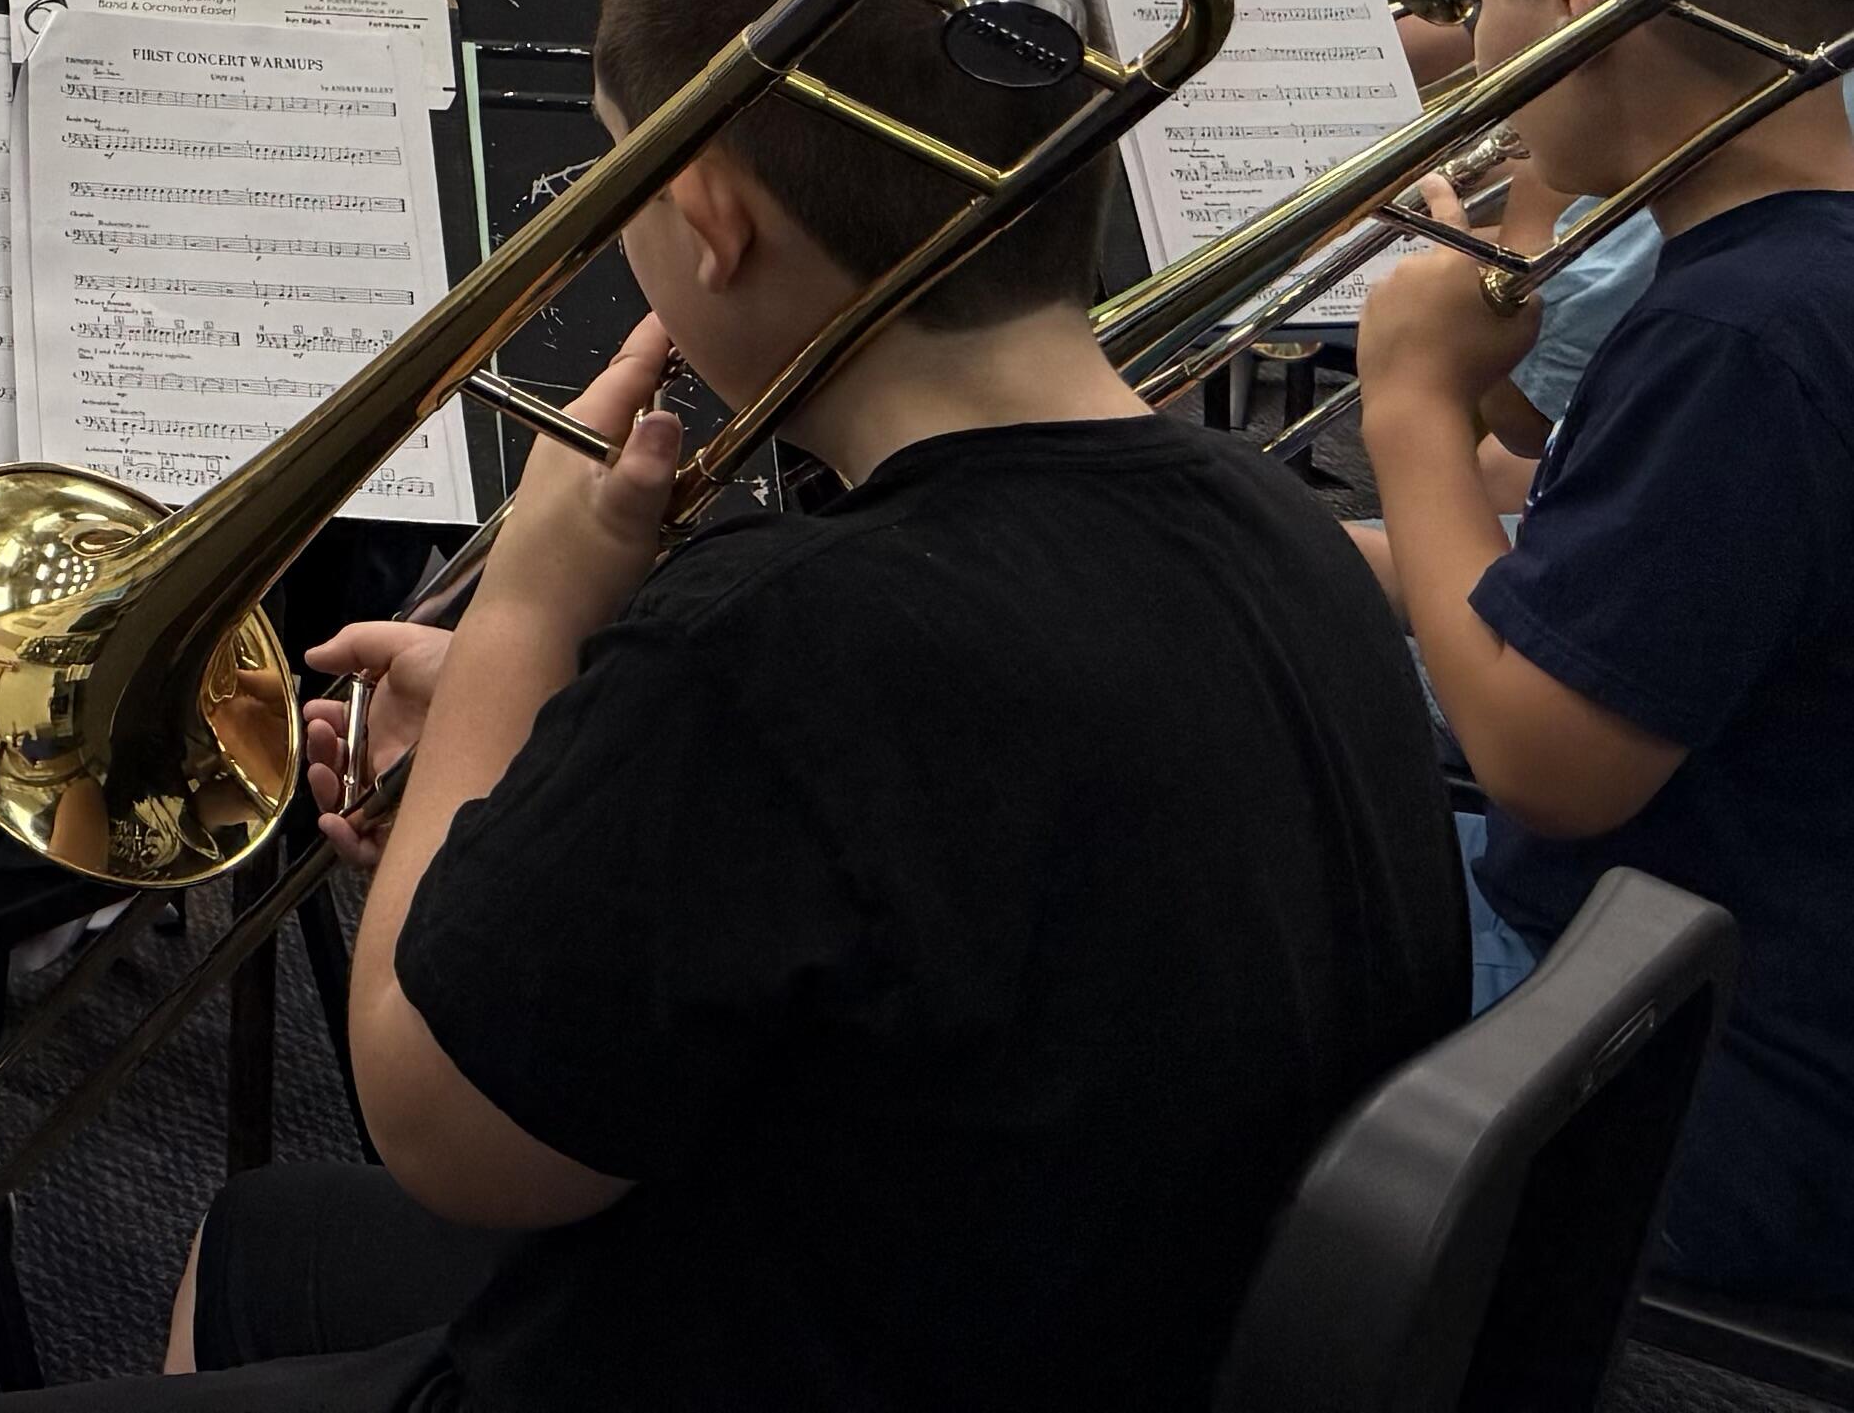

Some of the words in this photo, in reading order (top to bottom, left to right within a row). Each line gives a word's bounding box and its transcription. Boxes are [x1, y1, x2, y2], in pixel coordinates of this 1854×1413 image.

[97, 0, 125, 10] Band
[131, 2, 140, 11] &
[144, 2, 197, 15] Orchestra
[132, 48, 174, 63] FIRST
[176, 51, 247, 67] CONCERT
[250, 55, 324, 72] WARMUPS
